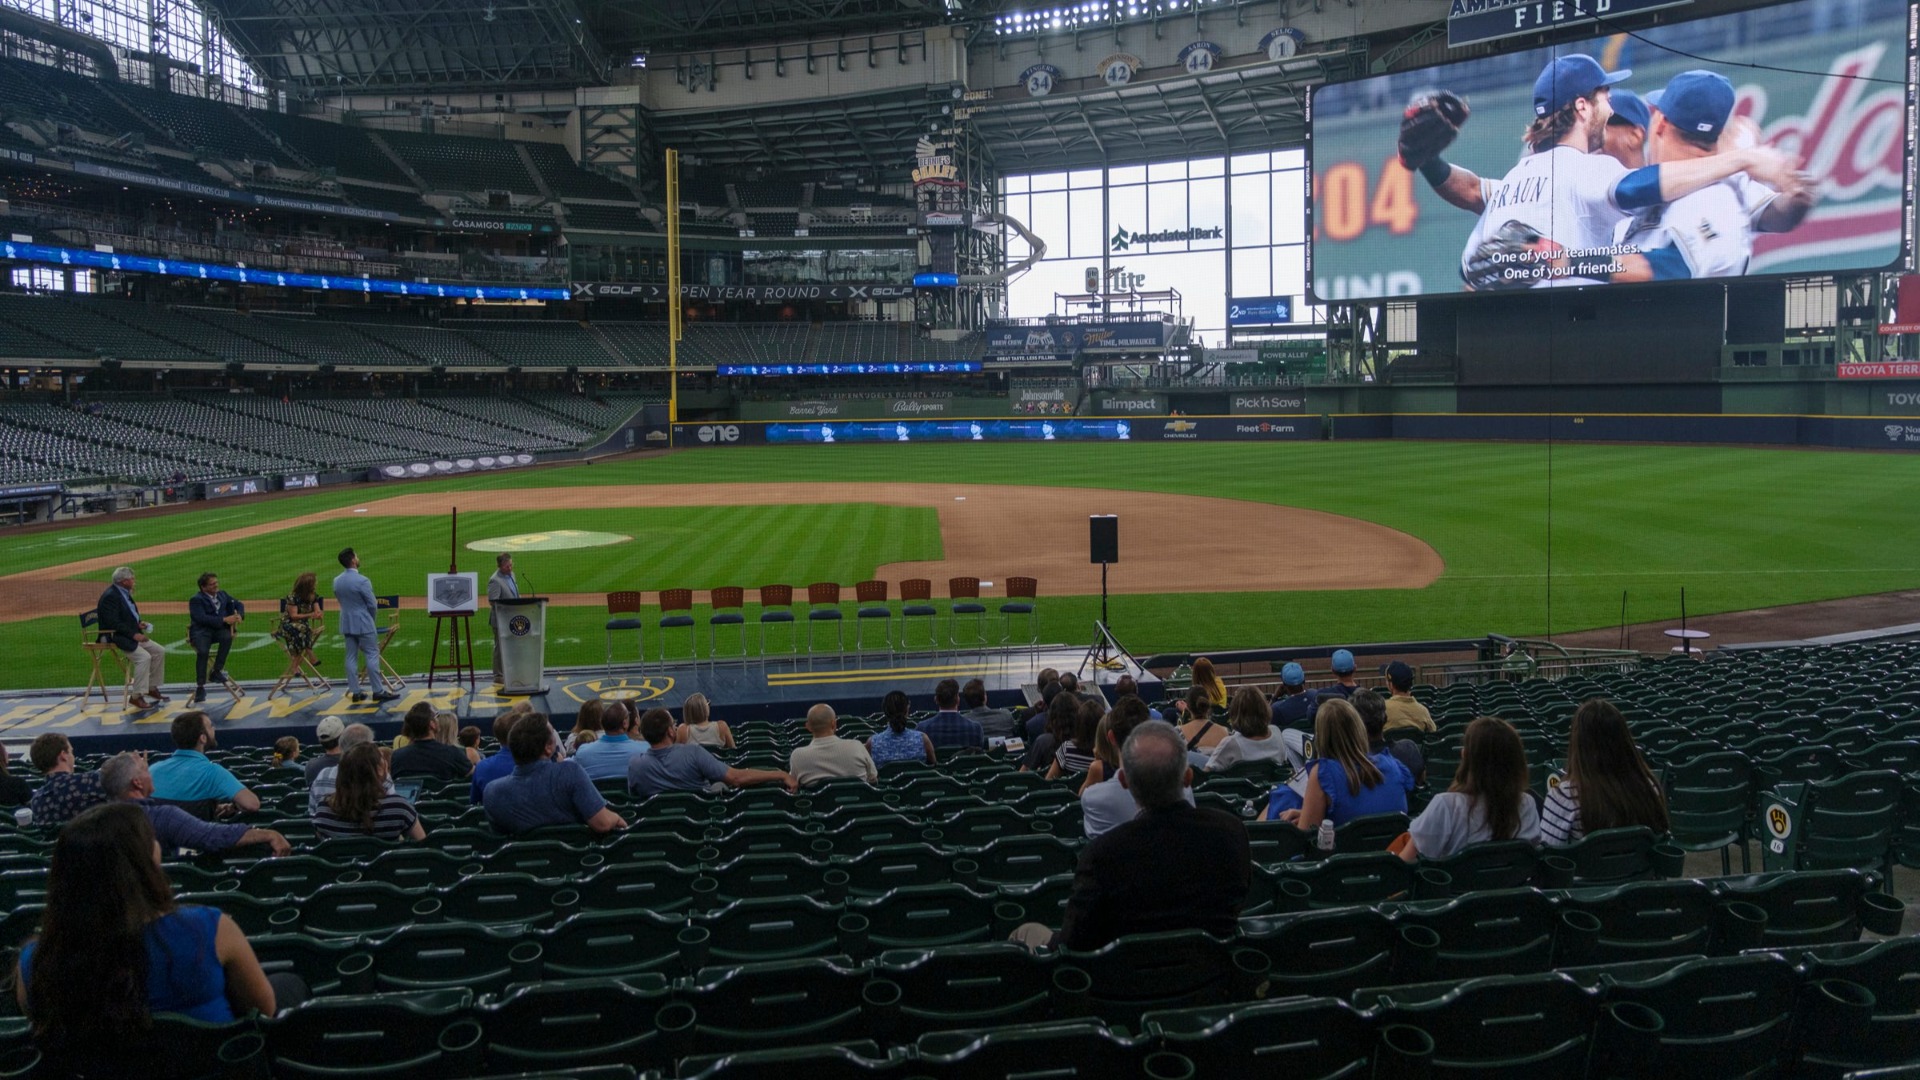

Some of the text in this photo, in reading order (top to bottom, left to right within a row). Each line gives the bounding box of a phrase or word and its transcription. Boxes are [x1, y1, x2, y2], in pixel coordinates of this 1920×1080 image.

[1515, 0, 1611, 28] FIELD
[1270, 28, 1293, 38] SELIG
[1187, 42, 1212, 52] AARON
[1278, 42, 1286, 56] 1
[1101, 55, 1135, 68] ROBINSON
[1189, 55, 1209, 70] 44
[1025, 65, 1055, 76] FINGERS
[1107, 66, 1127, 81] 42
[1030, 75, 1049, 92] 34
[911, 165, 958, 182] CHALET
[109, 169, 230, 198] Northwestern Mutual LEGENDS CLUB
[1490, 176, 1548, 214] BRAUN
[264, 197, 311, 210] Northwestern
[312, 204, 335, 213] Mutual
[452, 220, 504, 230] CASAMIGOS
[1130, 226, 1223, 244] Associated Bank
[1492, 244, 1642, 264] One of your teammates.
[1504, 268, 1529, 279] One
[1533, 265, 1546, 278] of
[1547, 266, 1575, 279] your
[1578, 261, 1627, 276] friends.
[1113, 272, 1146, 293] Lite
[600, 286, 642, 295] GOLF
[717, 287, 755, 298] YEAR
[765, 286, 820, 298] ROUND
[872, 287, 913, 296] GOLF
[1880, 325, 1913, 333] COURTESY
[1083, 330, 1116, 346] Miller
[1100, 338, 1157, 347] TIME, MILWAUKEE
[1841, 364, 1920, 376] TOYOTA TERR
[1021, 389, 1064, 401] Johnsonville
[893, 401, 922, 413] Bally
[1112, 398, 1156, 411] impact
[1271, 397, 1300, 408] Save
[790, 404, 838, 416] Barrel Yard
[698, 425, 740, 442] one
[1237, 425, 1259, 433] Fleet
